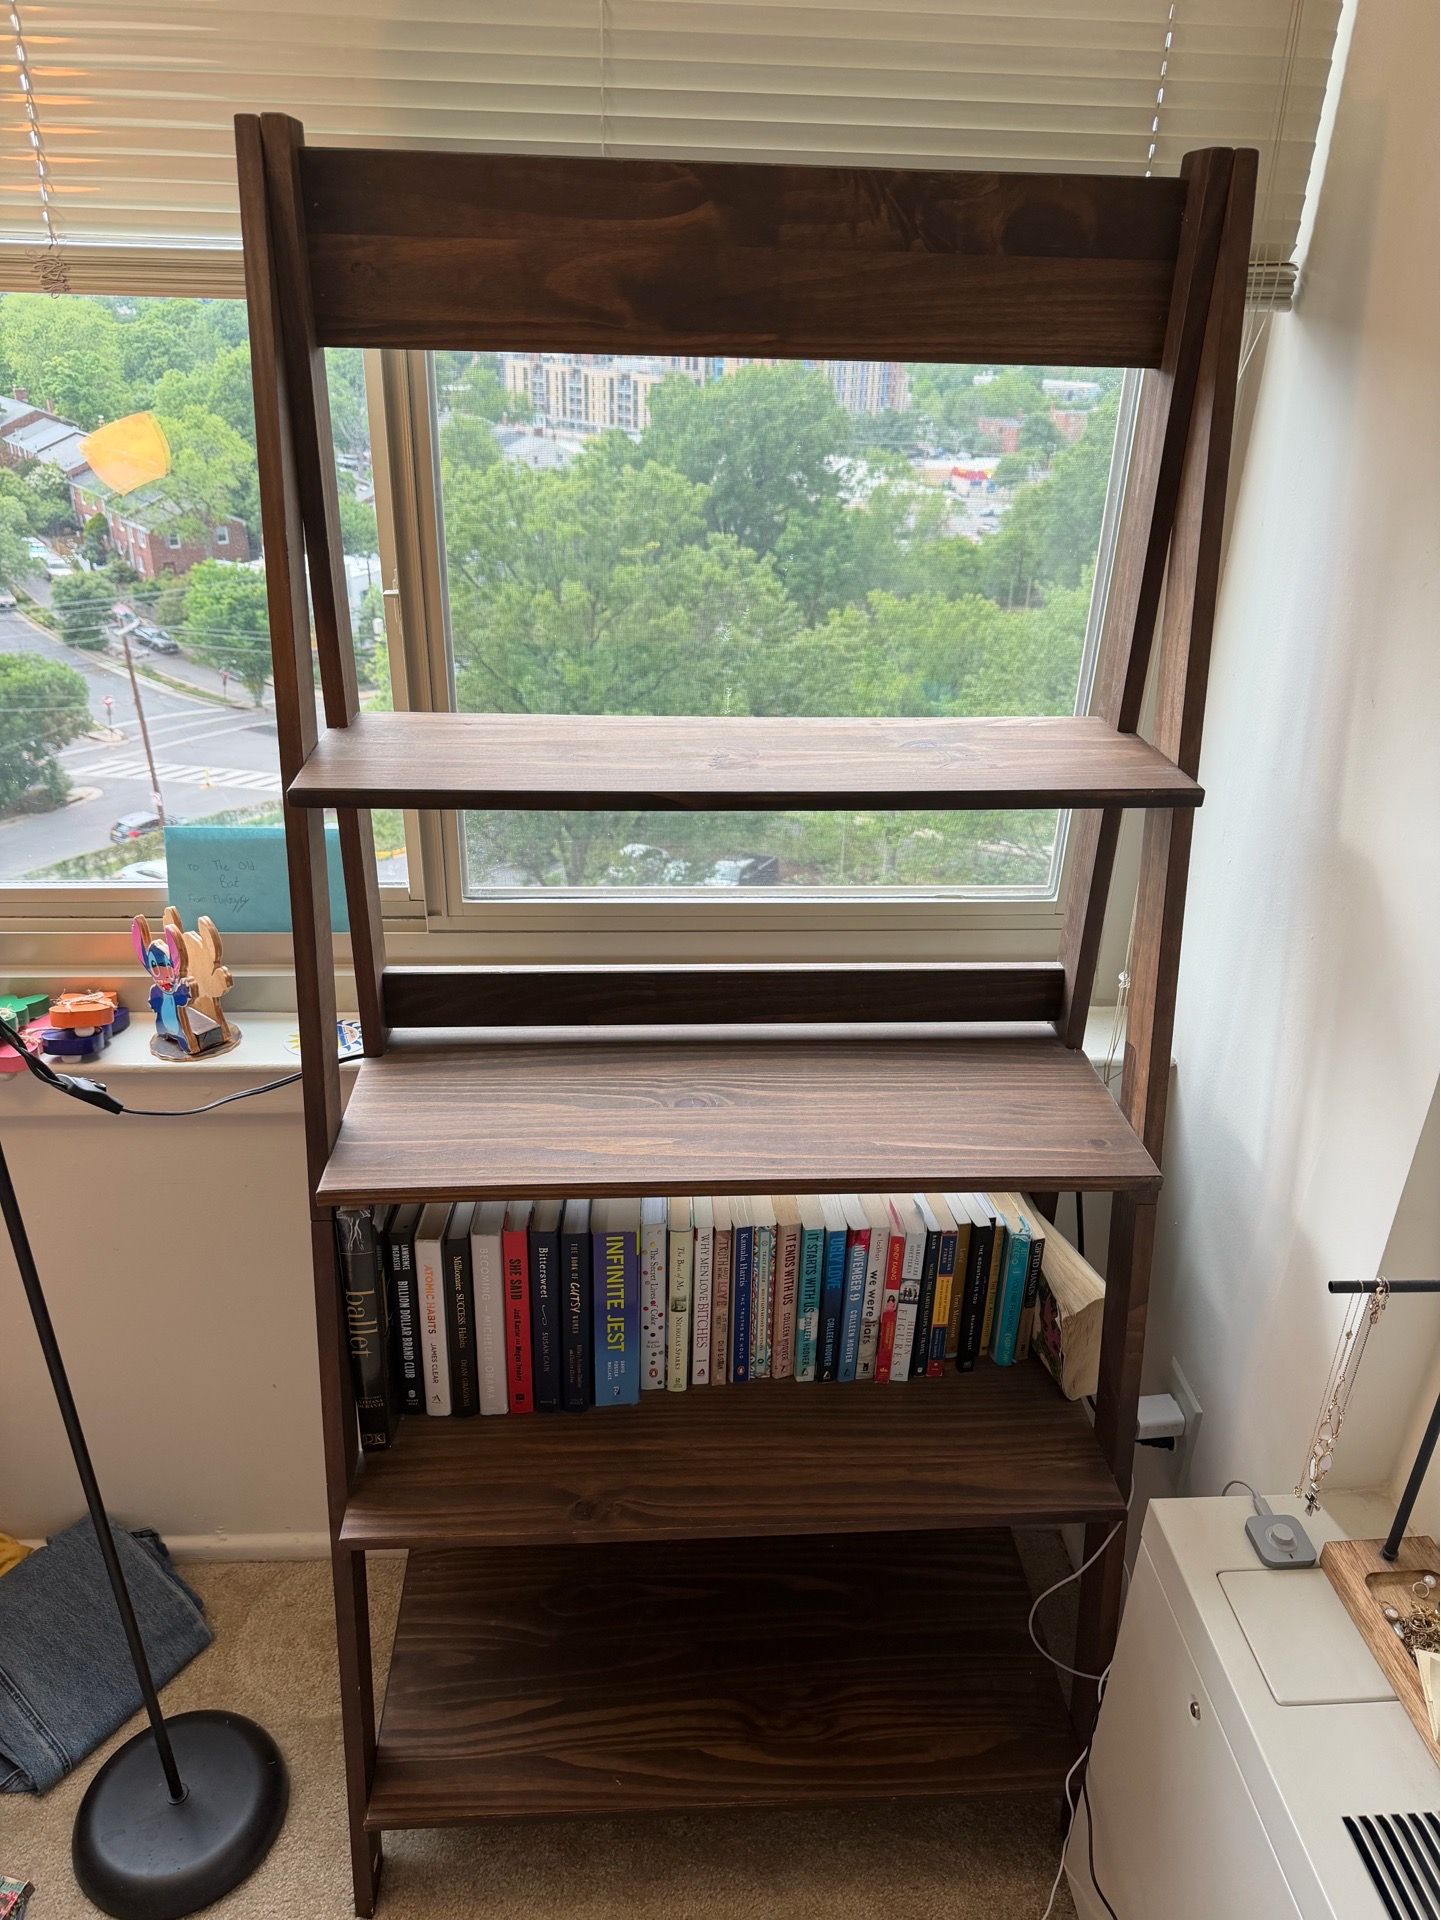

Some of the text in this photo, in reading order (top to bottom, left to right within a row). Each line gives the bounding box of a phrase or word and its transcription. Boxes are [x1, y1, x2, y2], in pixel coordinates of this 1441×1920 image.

[211, 859, 230, 872] The
[238, 860, 256, 871] Old
[219, 874, 240, 889] Bat
[391, 1244, 401, 1271] INGRASSIA
[401, 1244, 411, 1271] LAWRENCE
[570, 1242, 578, 1256] THE
[650, 1248, 659, 1261] The
[676, 1246, 685, 1258] The
[738, 1232, 749, 1287] Kamala Harris
[782, 1233, 797, 1306] IT ENDS WITH US
[827, 1236, 845, 1291] UGLY LOVE
[890, 1243, 900, 1281] MINDY KALING
[1032, 1242, 1043, 1268] GIFTED
[479, 1247, 492, 1301] BECOMING
[508, 1258, 522, 1301] SHE SAID
[538, 1246, 549, 1299] Bittersweet
[650, 1261, 660, 1282] Secret
[650, 1283, 659, 1299] Lives
[696, 1234, 711, 1349] WHY MEN LOVE BITCHES
[803, 1233, 819, 1314] IT STARTS WITH US
[849, 1244, 866, 1301] NOVEMBER 9
[927, 1263, 935, 1280] WHILE
[1027, 1268, 1038, 1296] HANDS
[423, 1264, 438, 1335] ATOMIC HABITS
[453, 1255, 467, 1350] Millionaire SUCCESS Habits
[569, 1280, 581, 1313] GUTSY
[606, 1235, 626, 1352] INFINITE JEST
[862, 1269, 879, 1346] we were liars
[924, 1291, 932, 1309] EARTH
[346, 1288, 378, 1358] ballet
[397, 1280, 416, 1379] BILLION DOLLAR BRAND CLUB
[675, 1316, 684, 1347] NICHOLAS
[781, 1312, 791, 1361] COLLEEN HOOVER
[845, 1309, 858, 1363] COLLEEN HOOVER
[922, 1309, 931, 1328] SLEEPS
[949, 1293, 961, 1339] Toni Morrison
[484, 1313, 495, 1363] MICHELLE
[542, 1331, 552, 1373] SUSAN CAIN
[739, 1333, 745, 1341] WE
[801, 1316, 813, 1366] COLLEEN HOOVER
[824, 1317, 836, 1367] COLLEEN HOOVER
[893, 1308, 907, 1367] FIGURES
[904, 1320, 915, 1355] HIDDEN
[919, 1336, 928, 1355] TRAVEL
[430, 1343, 440, 1384] JAMES CLEAR
[674, 1347, 684, 1371] SPARKS
[485, 1364, 497, 1400] OBAMA
